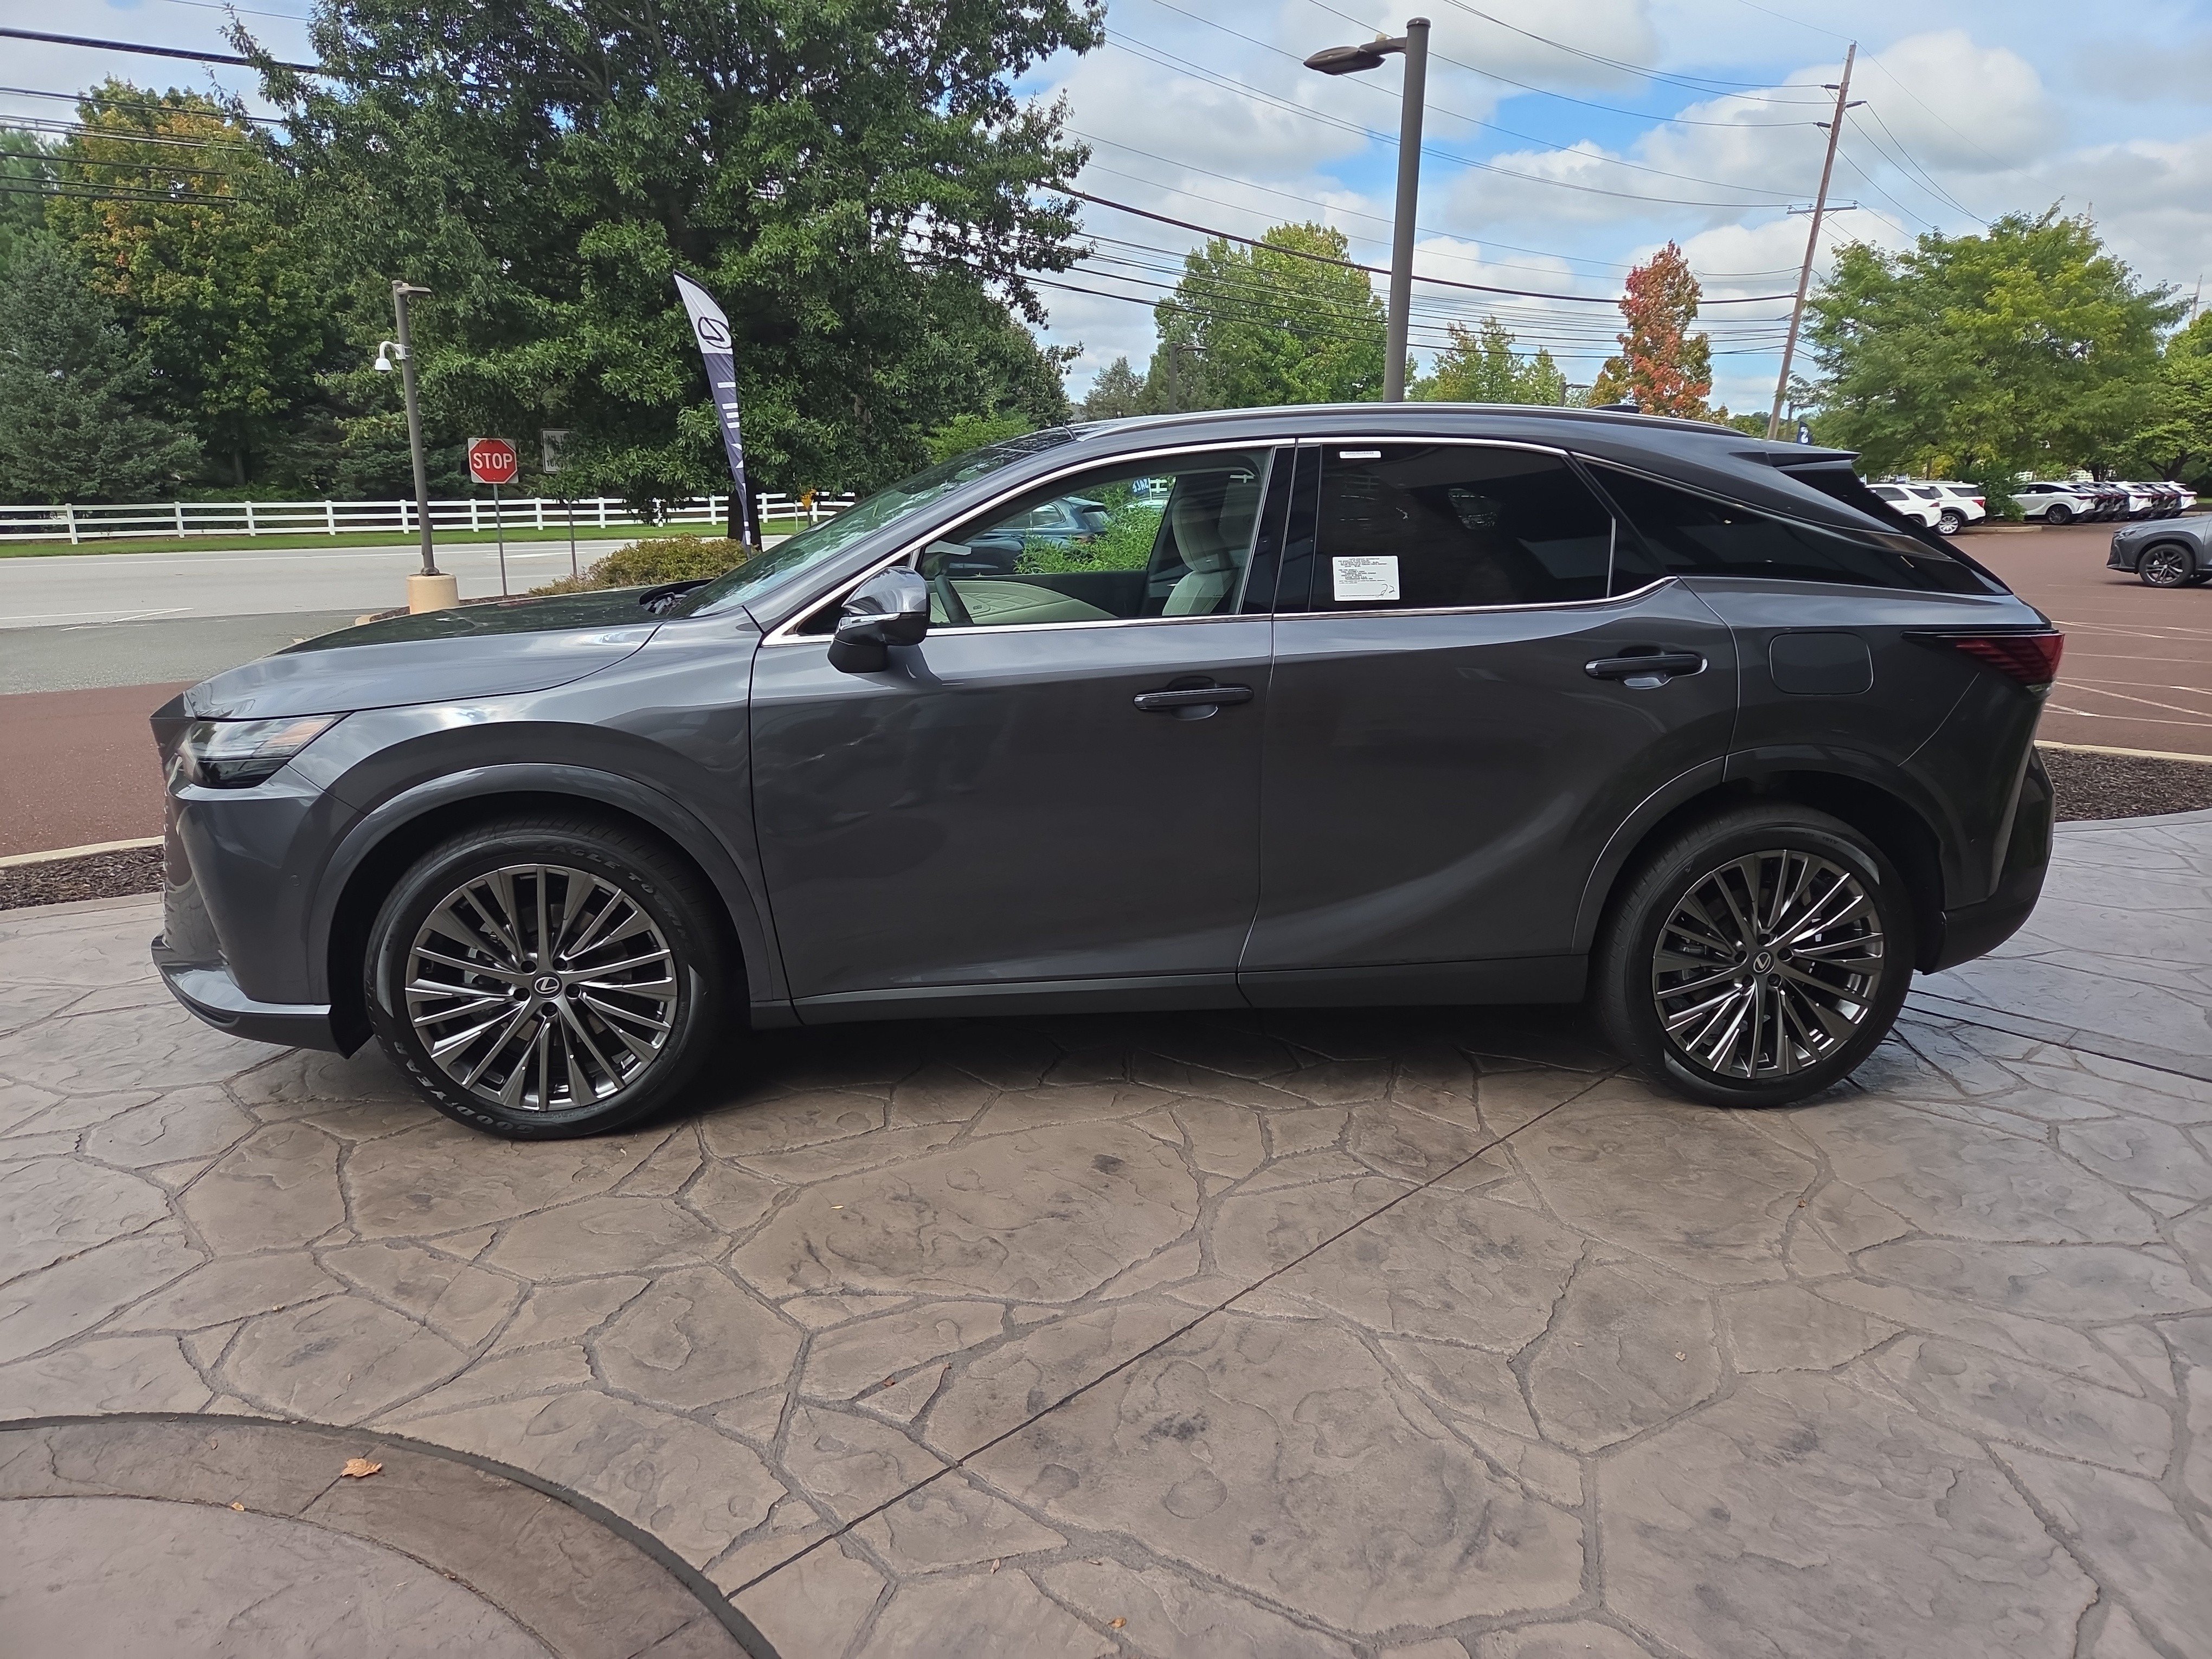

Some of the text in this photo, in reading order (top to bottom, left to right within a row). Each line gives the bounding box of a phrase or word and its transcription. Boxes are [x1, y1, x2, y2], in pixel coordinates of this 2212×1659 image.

[473, 453, 513, 469] STOP
[536, 843, 692, 946] EAGLE TOURIN
[394, 1041, 535, 1133] GOODYEAR
